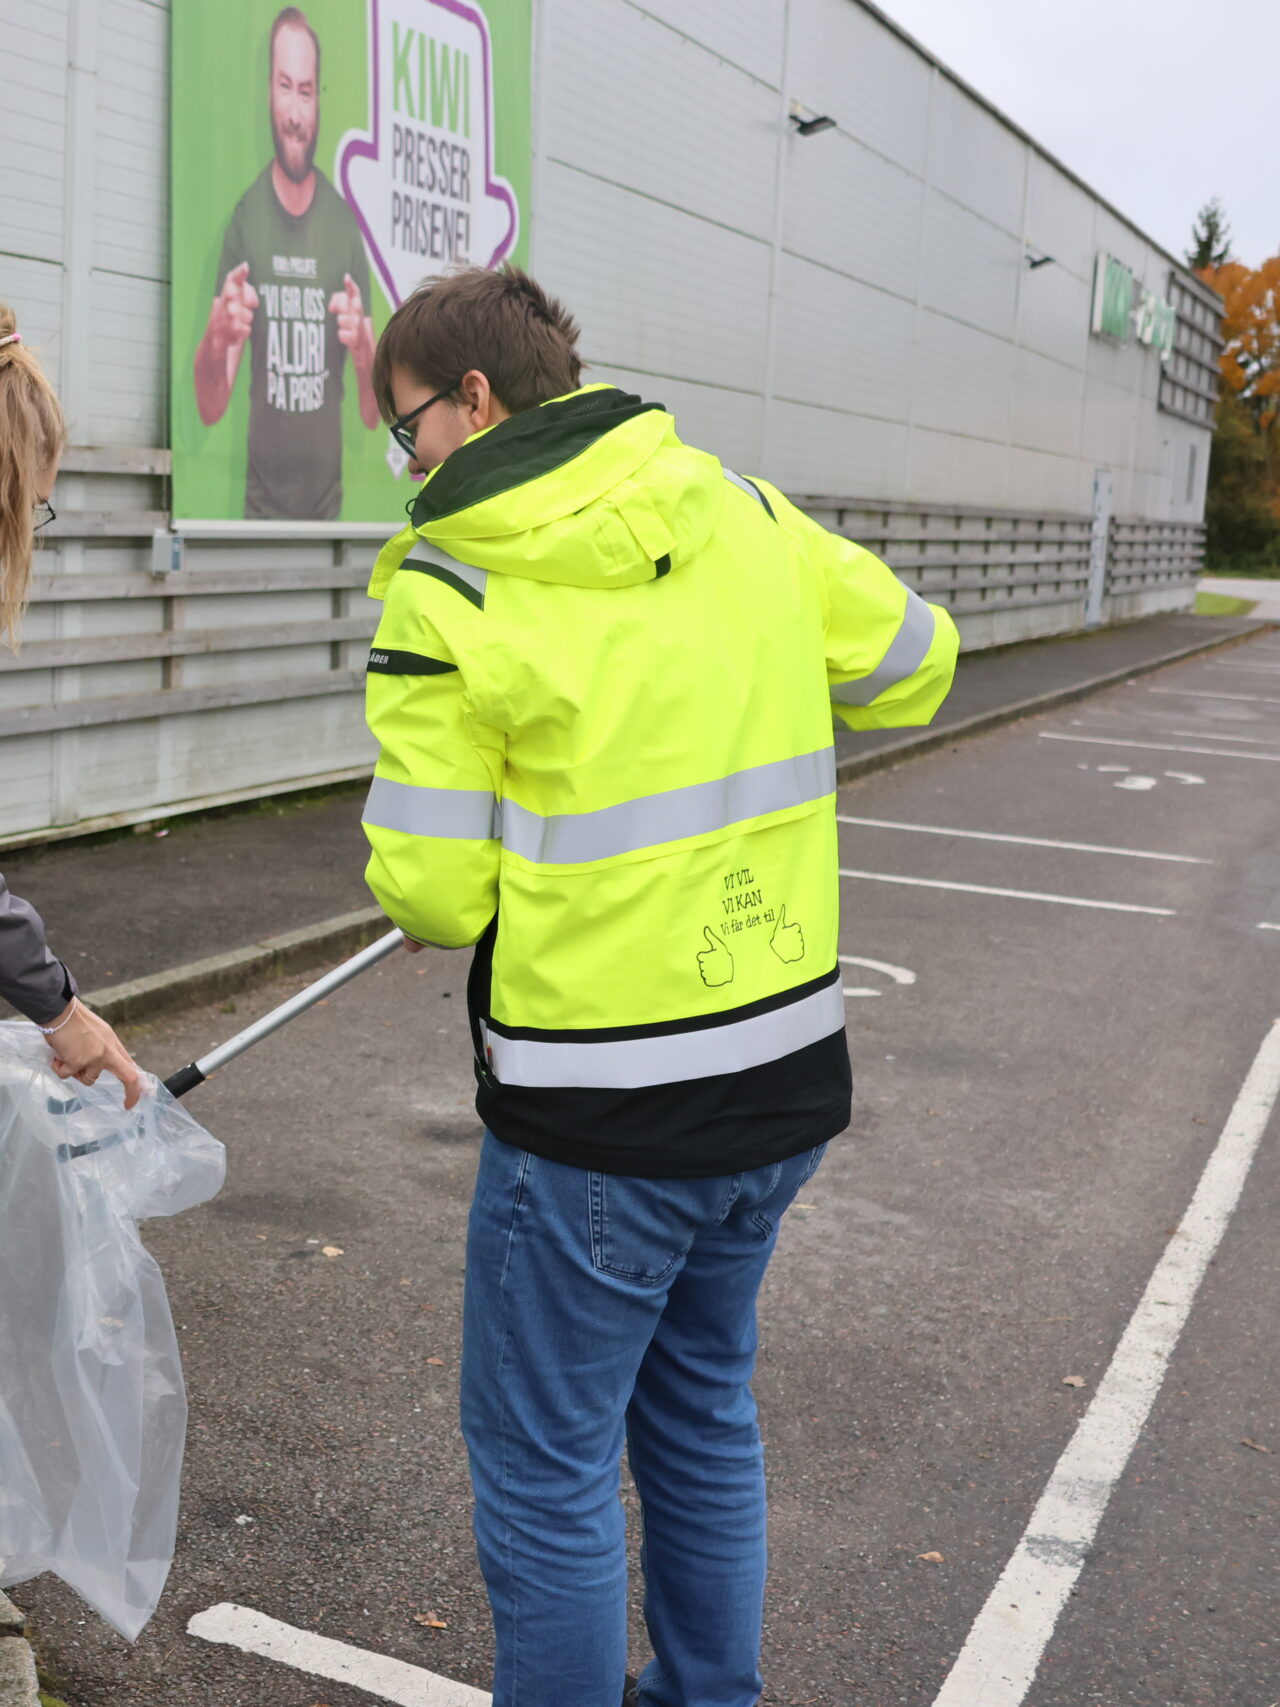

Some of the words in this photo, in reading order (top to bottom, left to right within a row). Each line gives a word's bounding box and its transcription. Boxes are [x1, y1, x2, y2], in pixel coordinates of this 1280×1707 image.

[392, 20, 470, 139] KIWI
[392, 122, 471, 203] PRESSER
[391, 190, 471, 265] PRISENE!
[303, 287, 326, 322] OSS
[267, 320, 325, 376] ALDRI
[370, 652, 389, 665] ÄDER
[724, 873, 735, 891] VI
[736, 868, 754, 886] VIL
[722, 897, 735, 915] VI
[736, 889, 763, 912] KAN
[720, 923, 730, 936] Vi
[731, 919, 743, 934] får
[746, 914, 761, 929] det
[763, 908, 775, 923] til
